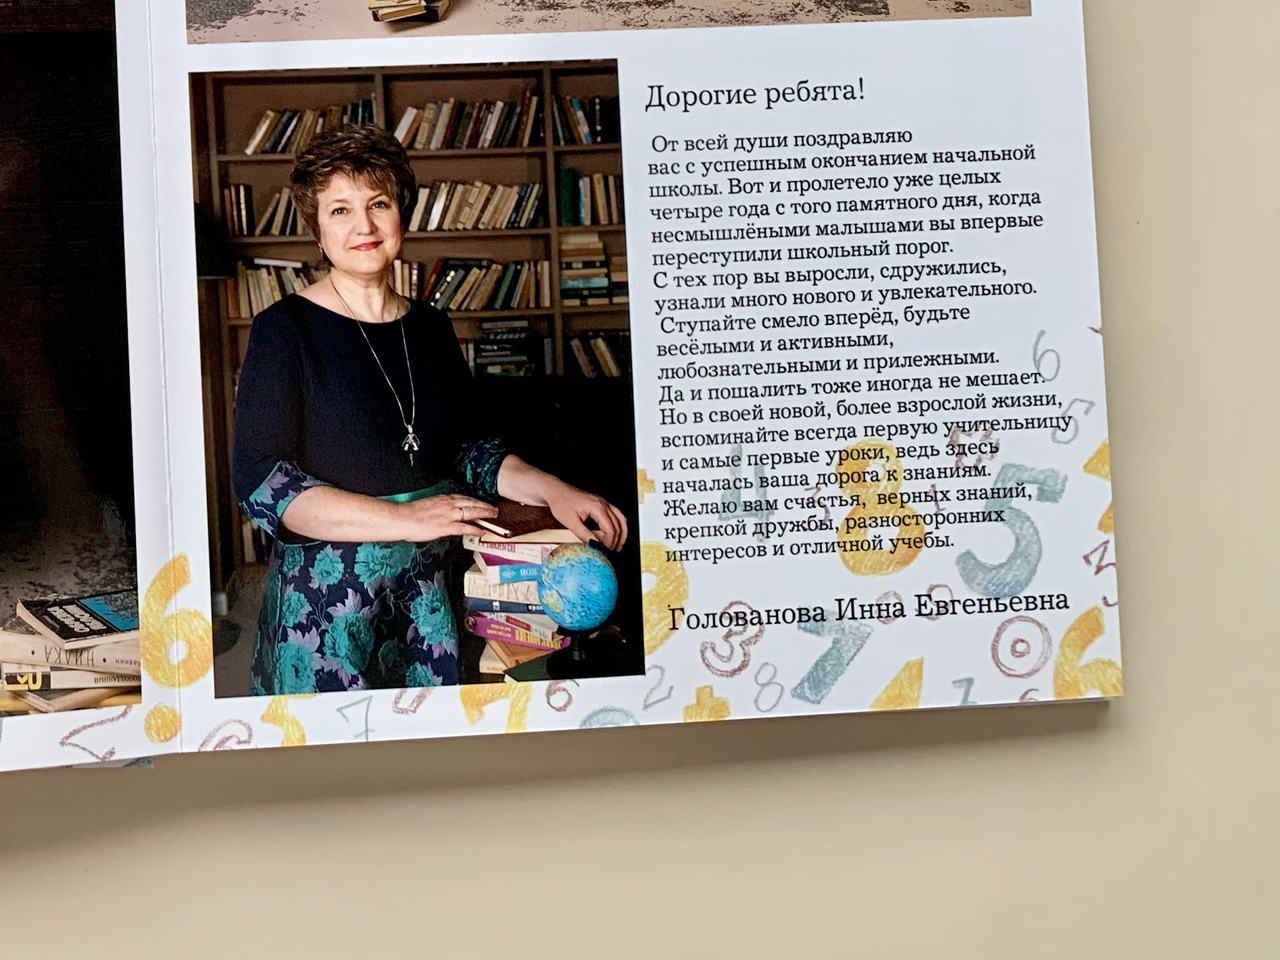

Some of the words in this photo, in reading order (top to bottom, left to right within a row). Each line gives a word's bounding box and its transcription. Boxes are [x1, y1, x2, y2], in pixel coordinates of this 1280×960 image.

[644, 84, 757, 113] Дорогие
[764, 77, 864, 110] ребята!
[651, 135, 679, 153] От
[684, 133, 729, 151] всей
[733, 135, 789, 154] души
[793, 130, 913, 150] поздравляю
[648, 162, 681, 175] вас
[685, 161, 695, 174] с
[700, 157, 807, 178] успешным
[811, 152, 928, 169] окончанием
[932, 143, 1036, 164] начальной
[648, 183, 723, 198] школы.
[727, 177, 765, 195] Вот
[769, 180, 782, 193] и
[786, 176, 889, 197] пролетело
[892, 174, 934, 192] уже
[938, 171, 1002, 189] целых
[650, 205, 723, 223] четыре
[728, 203, 771, 219] года
[775, 203, 786, 216] с
[789, 201, 832, 215] того
[836, 196, 938, 213] памятного
[942, 195, 983, 211] дня,
[988, 192, 1042, 208] когда
[651, 222, 811, 243] несмышлёными
[815, 220, 924, 237] малышами
[928, 218, 956, 231] вы
[960, 214, 1044, 234] впервые
[652, 248, 783, 270] переступили
[787, 239, 891, 260] школьный
[895, 241, 954, 259] порог.
[653, 271, 668, 289] С
[672, 274, 708, 288] тех
[712, 272, 748, 290] пор
[753, 271, 780, 284] вы
[784, 267, 875, 287] выросли,
[879, 261, 1007, 282] сдружились,
[654, 296, 726, 316] узнали
[730, 293, 788, 308] много
[792, 290, 856, 305] нового
[860, 289, 873, 302] и
[877, 282, 1037, 306] увлекательного.
[660, 314, 757, 338] Ступайте
[761, 314, 820, 330] смело
[823, 307, 899, 329] вперёд,
[903, 305, 971, 327] будьте
[656, 338, 755, 357] весёлыми
[759, 339, 773, 352] и
[777, 334, 894, 351] активными,
[657, 359, 842, 380] любознательными
[846, 358, 859, 371] и
[863, 351, 1000, 374] прилежными.
[658, 385, 685, 406] Да
[690, 388, 703, 401] и
[707, 383, 807, 400] пошалить
[811, 380, 862, 395] тоже
[866, 377, 933, 393] иногда
[938, 375, 961, 389] не
[965, 371, 1046, 387] мешает.
[659, 408, 688, 426] Но
[692, 411, 704, 424] в
[708, 403, 764, 423] своей
[768, 400, 832, 421] новой,
[836, 398, 892, 417] более
[896, 392, 987, 417] взрослой
[991, 394, 1063, 409] жизни,
[660, 426, 790, 448] вспоминайте
[794, 426, 858, 442] всегда
[863, 422, 938, 441] первую
[942, 415, 1073, 439] учительницу
[661, 459, 674, 471] и
[679, 454, 742, 470] самые
[746, 450, 820, 470] первые
[824, 447, 890, 467] уроки,
[895, 445, 941, 460] ведь
[945, 441, 1000, 457] здесь
[662, 477, 754, 494] началась
[758, 473, 811, 491] ваша
[815, 470, 881, 492] дорога
[885, 469, 899, 482] к
[902, 464, 992, 481] знаниям.
[663, 498, 738, 517] Желаю
[742, 498, 779, 513] вам
[783, 494, 867, 514] счастья,
[876, 487, 952, 507] верных
[956, 481, 1032, 502] знаний,
[664, 519, 748, 544] крепкой
[751, 514, 840, 539] дружбы,
[844, 509, 1006, 535] разносторонних
[665, 545, 768, 565] интересов
[772, 544, 785, 556] и
[789, 534, 884, 556] отличной
[888, 530, 955, 555] учебы.
[667, 605, 828, 631] Голованова
[834, 597, 907, 622] Инна
[913, 592, 1070, 617] Евгеньевна
